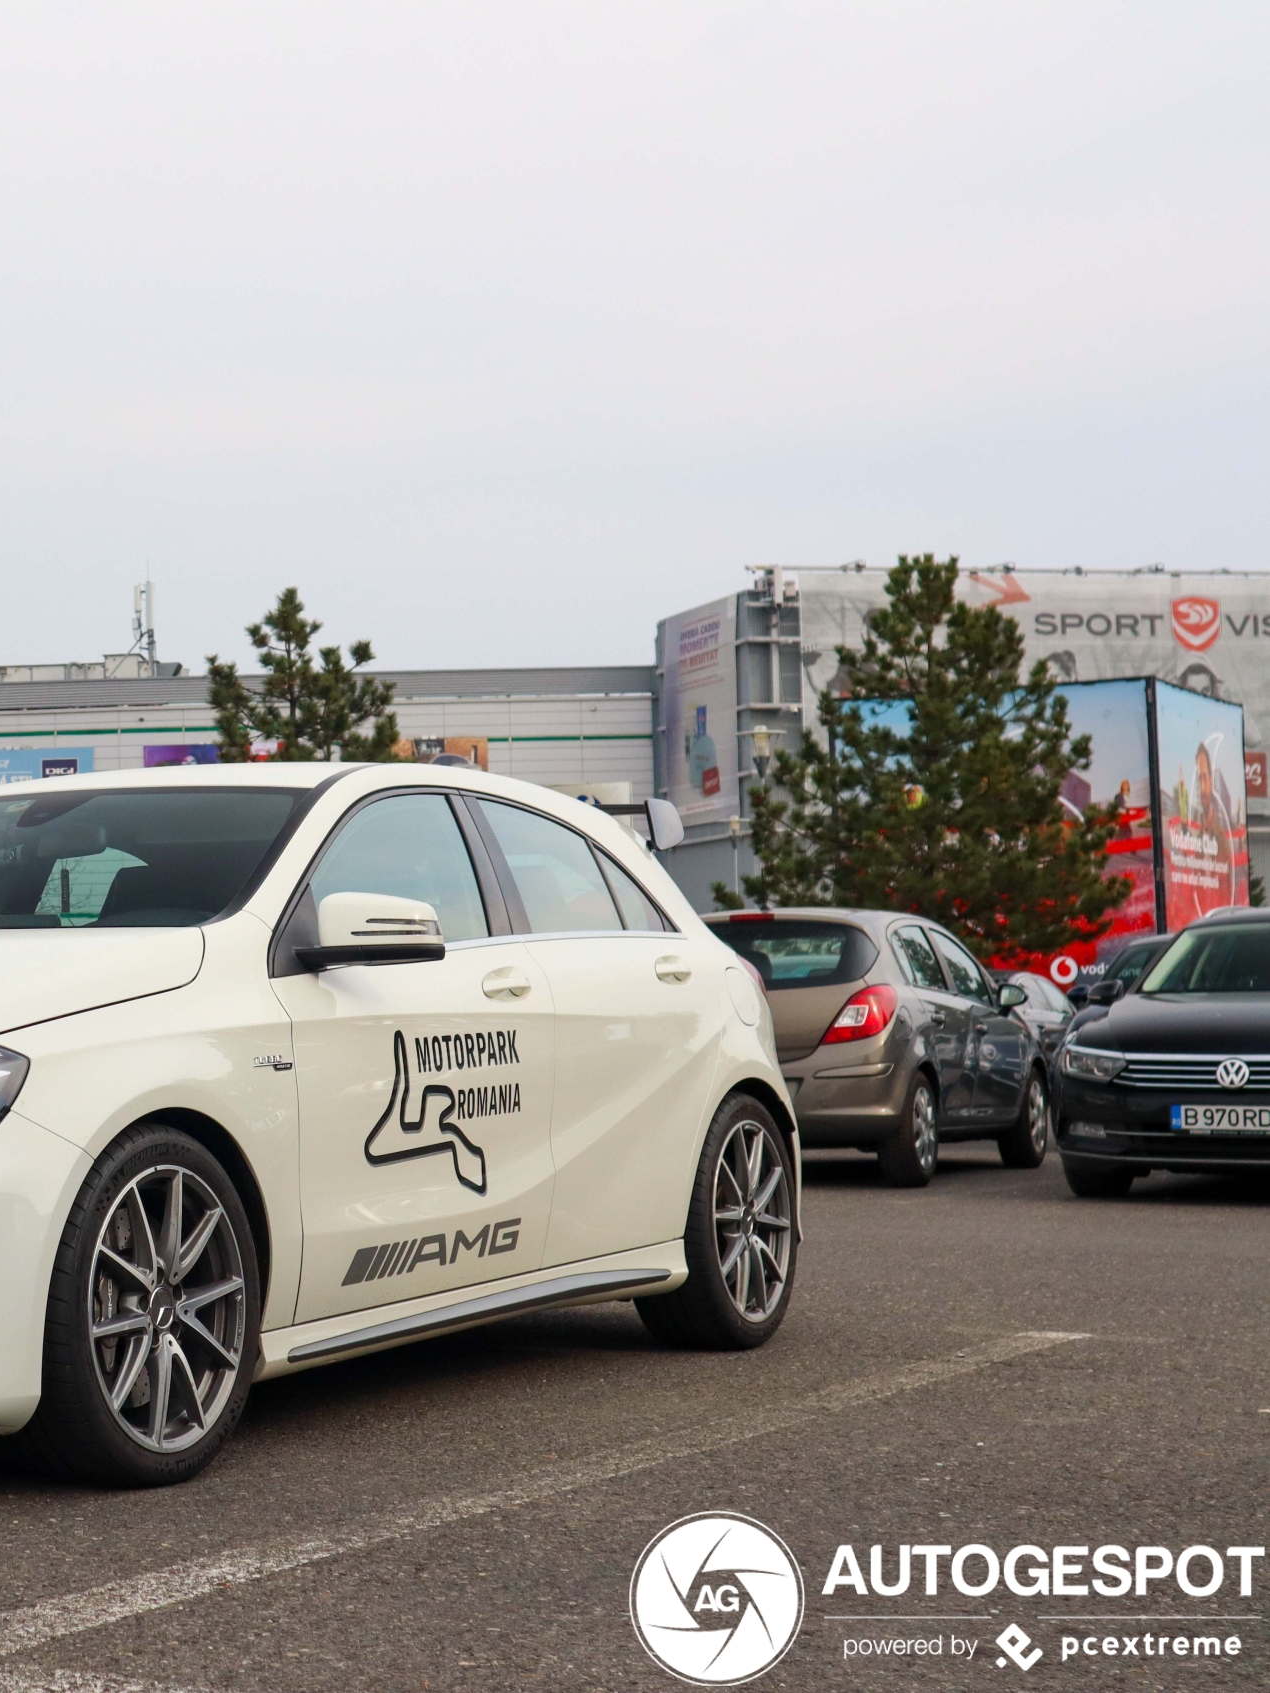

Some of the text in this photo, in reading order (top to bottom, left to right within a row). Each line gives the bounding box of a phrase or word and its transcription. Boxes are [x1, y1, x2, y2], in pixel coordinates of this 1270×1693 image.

[1034, 613, 1164, 636] SPORT
[679, 632, 719, 656] MOMENTE
[45, 767, 75, 775] DIGI
[1170, 826, 1219, 856] Vodafone Club
[415, 1030, 520, 1073] MOTORPARK
[457, 1083, 522, 1120] ROMANIA
[1184, 1108, 1199, 1126] B
[1203, 1108, 1240, 1127] 970
[406, 1217, 522, 1274] AMG
